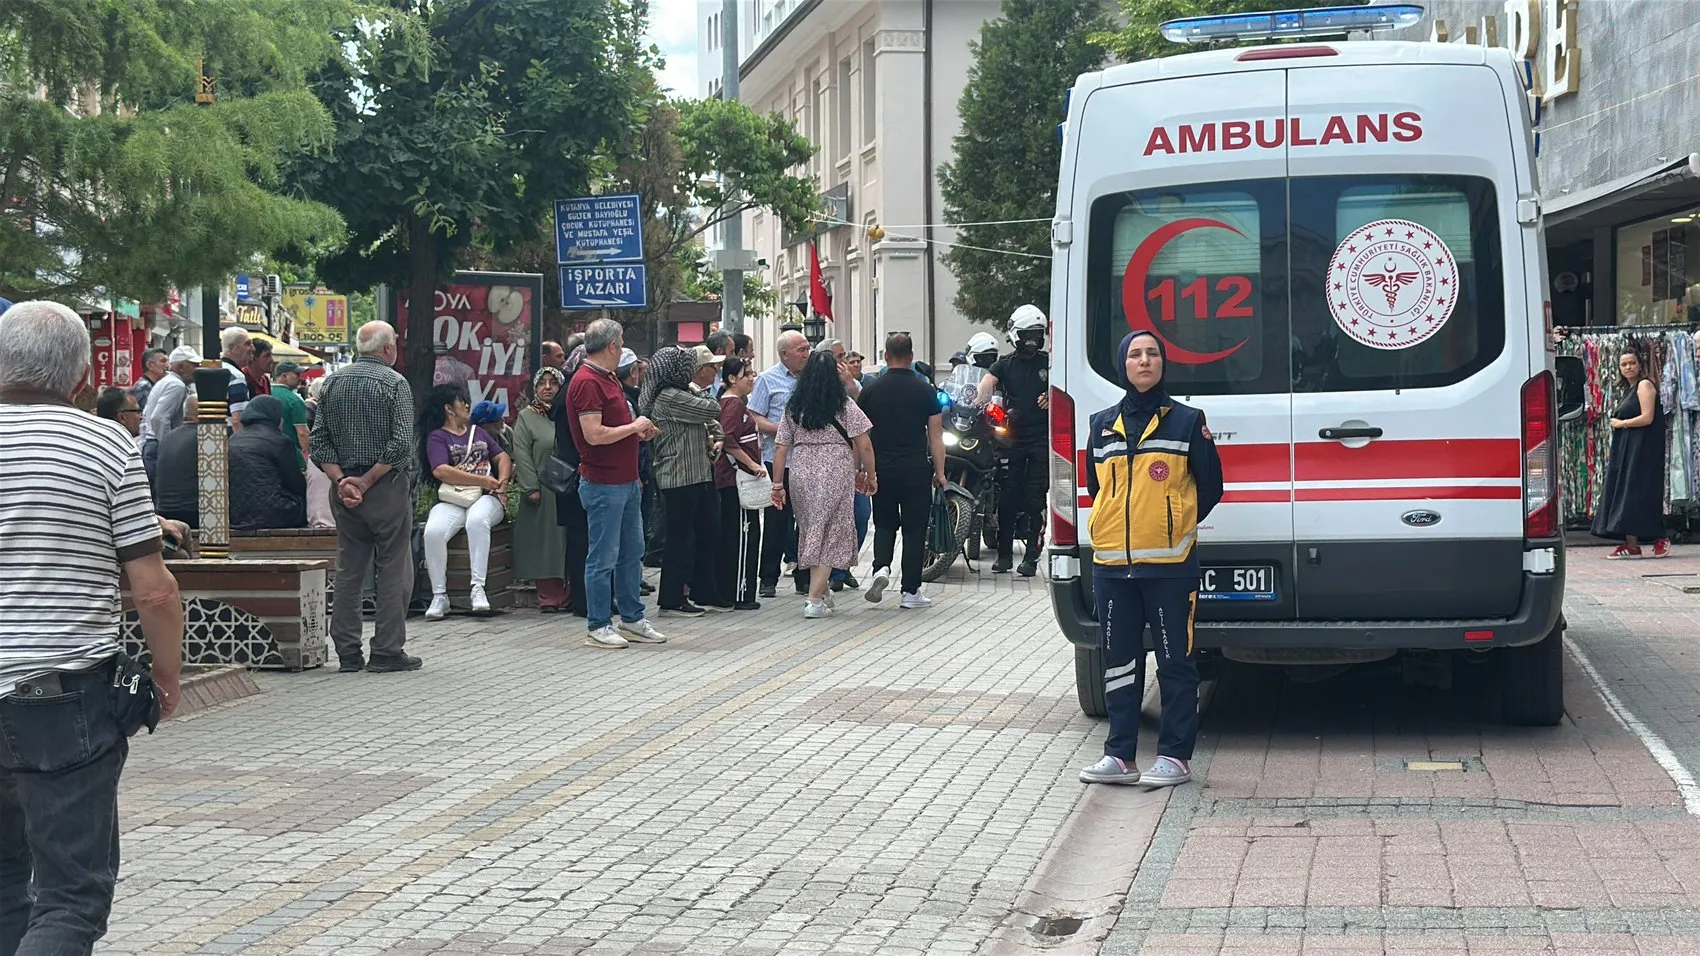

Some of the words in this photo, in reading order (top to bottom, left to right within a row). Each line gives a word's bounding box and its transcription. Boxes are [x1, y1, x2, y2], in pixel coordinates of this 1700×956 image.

[1142, 111, 1423, 157] AMBULANS
[561, 221, 584, 232] ÇOCUK
[567, 212, 592, 220] GÜLTEN
[564, 231, 574, 239] VE
[577, 229, 609, 238] MUSTAFA
[613, 228, 634, 238] YEŞİL
[1349, 242, 1398, 284] CUMHURİYETİ
[1400, 243, 1428, 269] SAĞLIK
[568, 267, 637, 283] İŞPORTA
[575, 282, 630, 295] PAZARI
[1148, 275, 1254, 321] 112
[1410, 270, 1433, 317] BAKANLIĞI
[1350, 287, 1374, 320] TÜRKİYE
[404, 315, 483, 351] OK
[1410, 512, 1433, 523] Ford
[1233, 568, 1265, 591] 501
